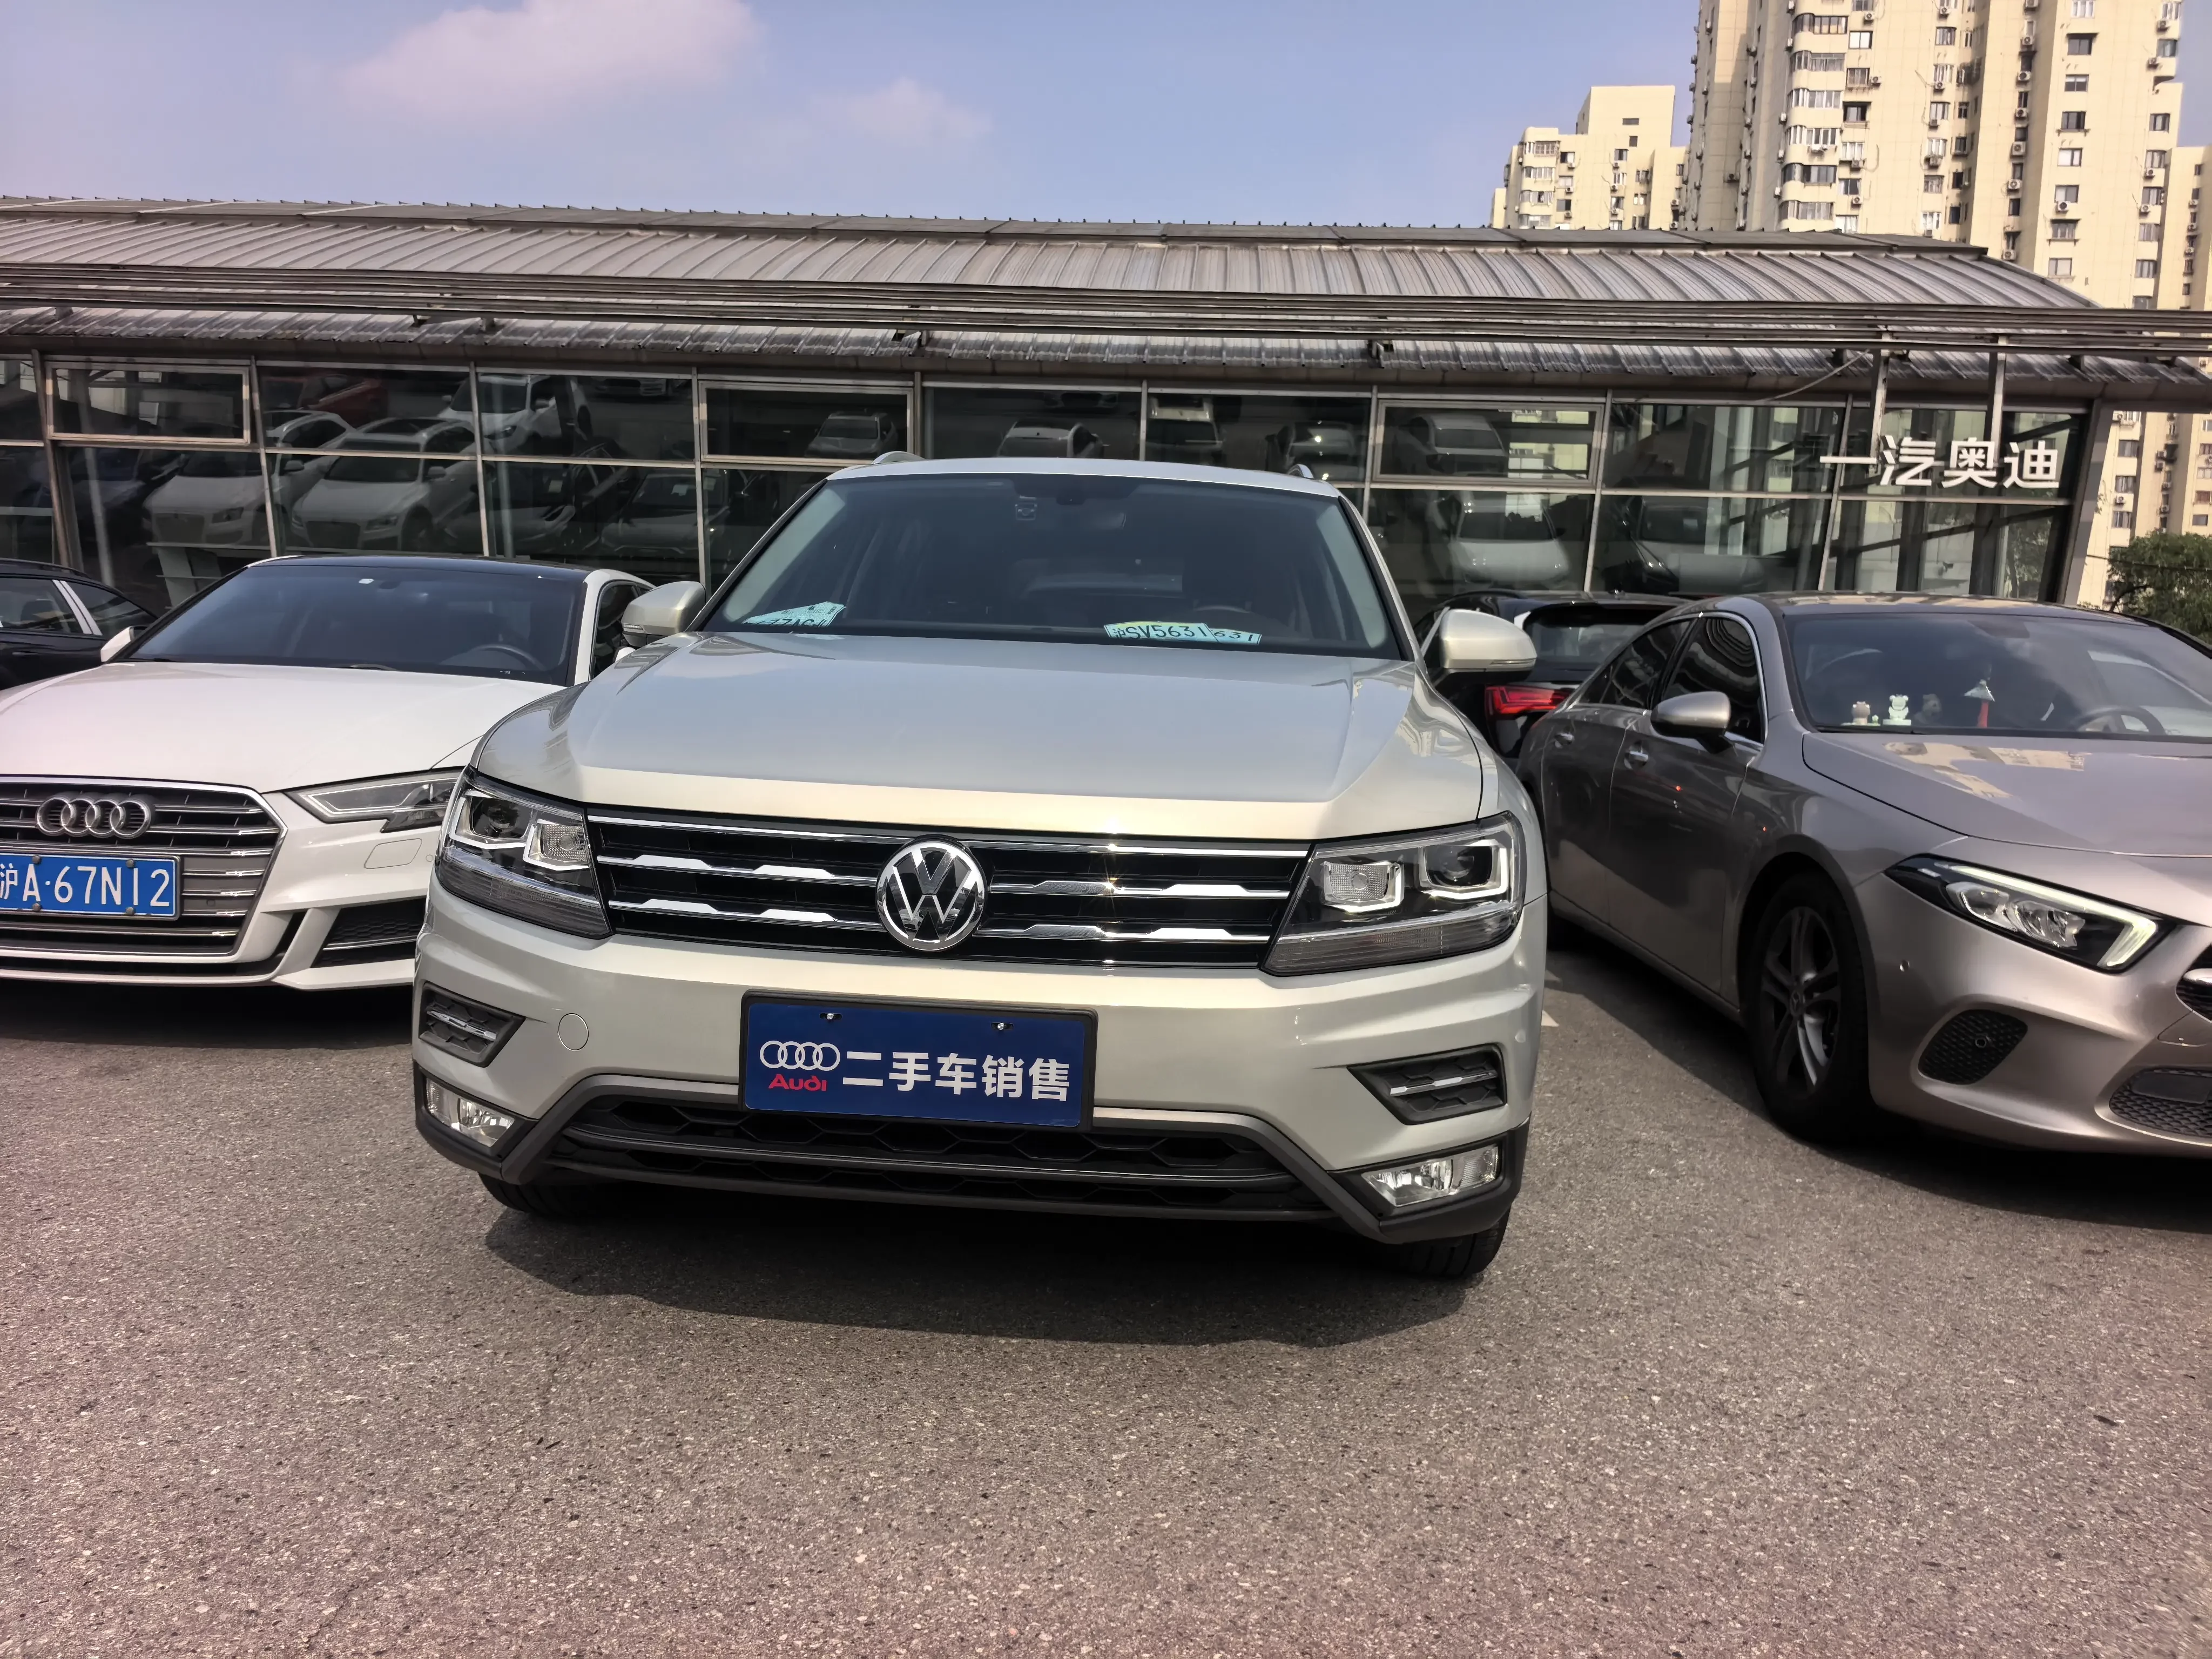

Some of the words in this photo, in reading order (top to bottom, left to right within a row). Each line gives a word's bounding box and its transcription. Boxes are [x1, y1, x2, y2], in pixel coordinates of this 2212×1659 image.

[1819, 435, 2059, 489] 一汽奥迪
[768, 1073, 827, 1092] Audi
[842, 1051, 1070, 1102] 二手车销售
